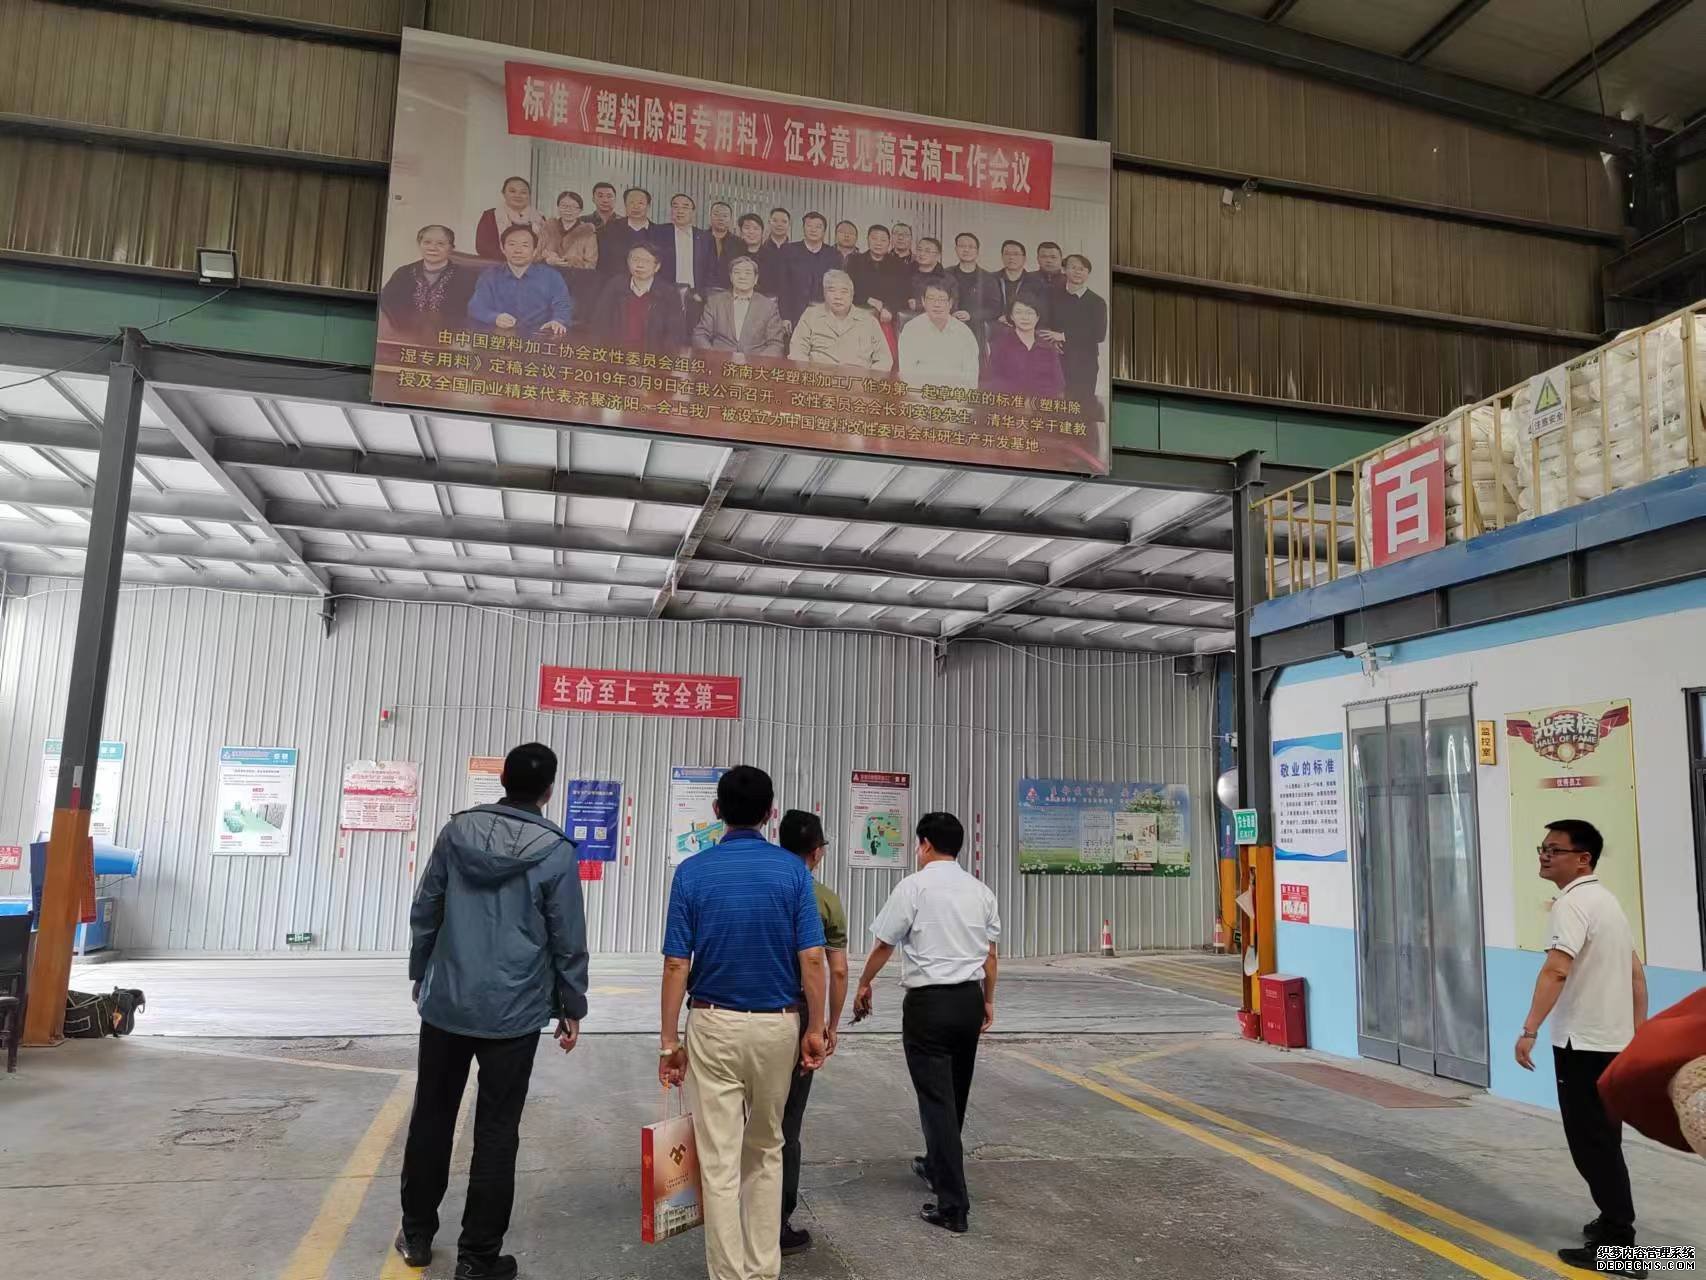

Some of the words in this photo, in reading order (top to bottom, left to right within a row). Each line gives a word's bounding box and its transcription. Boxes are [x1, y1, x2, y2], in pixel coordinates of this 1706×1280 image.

[522, 76, 1031, 193] 标准《塑料除湿专用料》征求意见稿定稿工作会议
[1375, 448, 1440, 554] 百
[553, 675, 637, 705] 生命至上
[652, 681, 734, 710] 安全第一
[1534, 713, 1599, 740] 光荣榜
[1535, 736, 1558, 748] HALL
[1558, 735, 1571, 743] OF
[1572, 735, 1598, 743] FAME
[1481, 727, 1491, 757] 监控室
[1280, 759, 1335, 778] 敬业的标准
